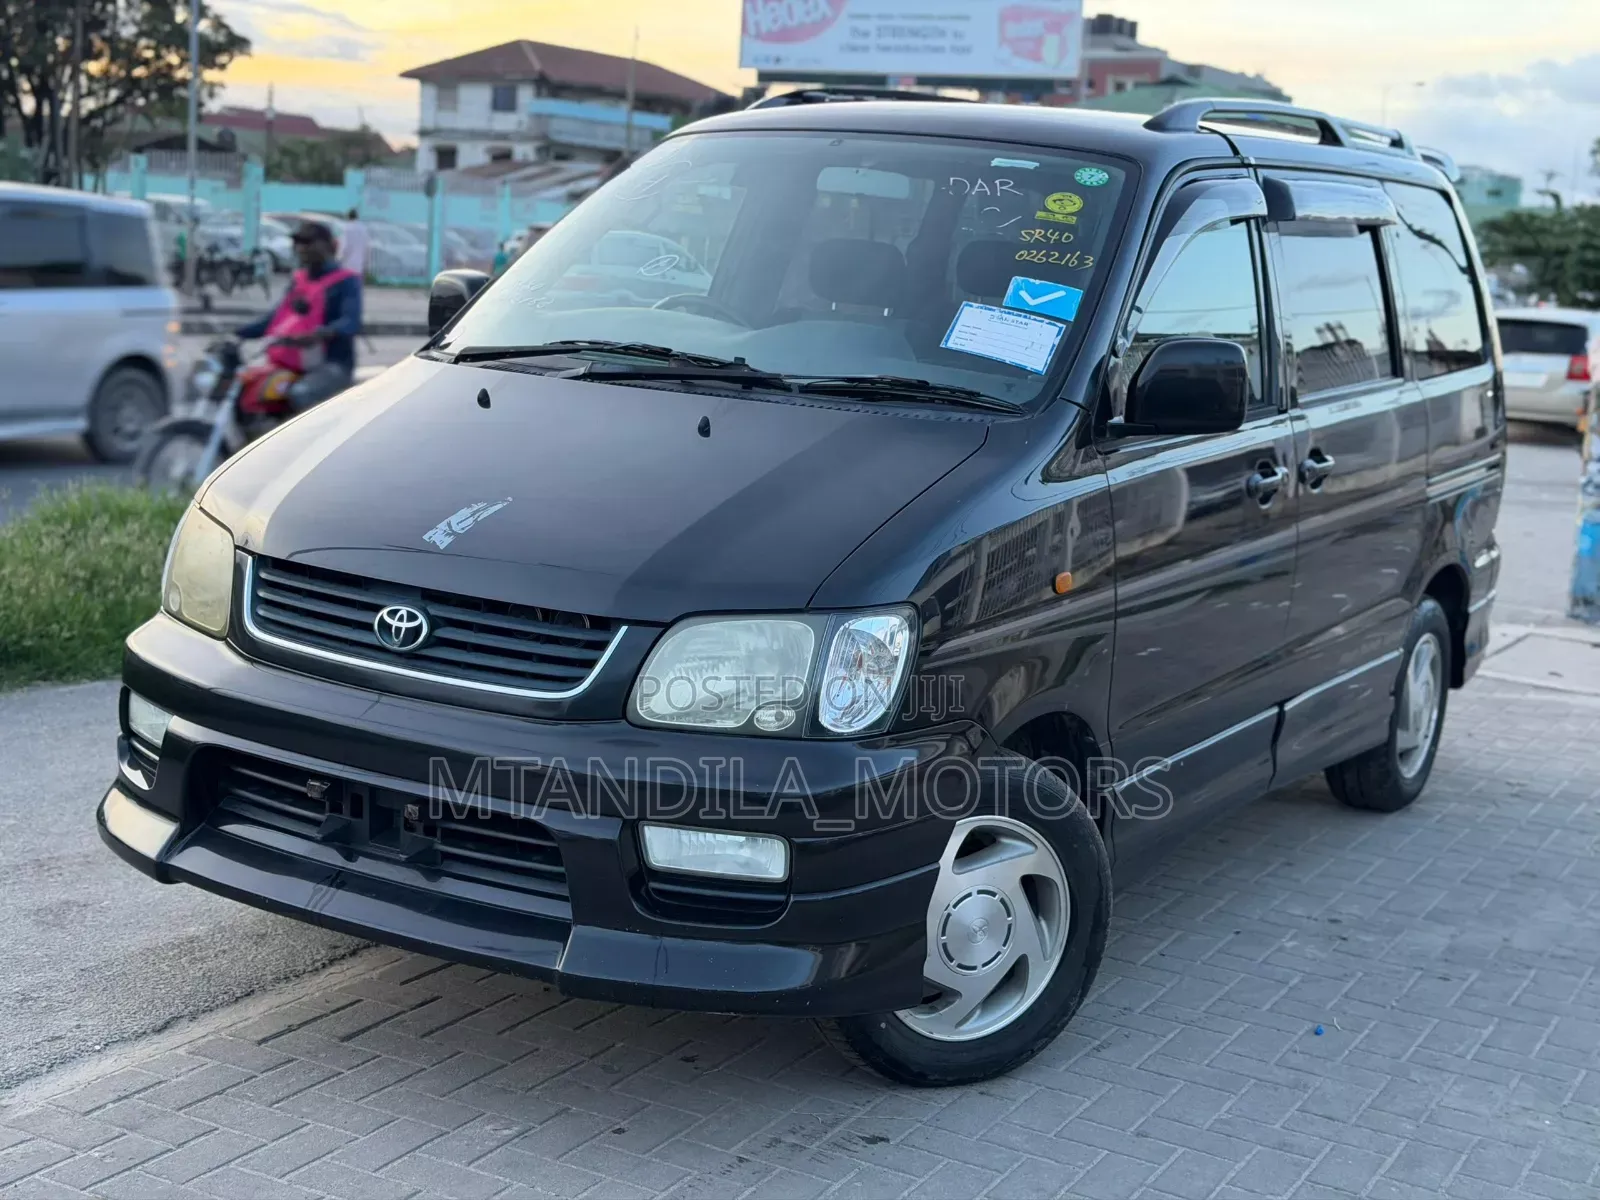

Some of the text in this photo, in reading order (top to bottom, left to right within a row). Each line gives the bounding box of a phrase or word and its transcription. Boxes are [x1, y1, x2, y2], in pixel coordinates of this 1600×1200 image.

[948, 176, 1024, 197] DAR
[1019, 229, 1074, 243] SR40
[1015, 250, 1094, 271] 0262163
